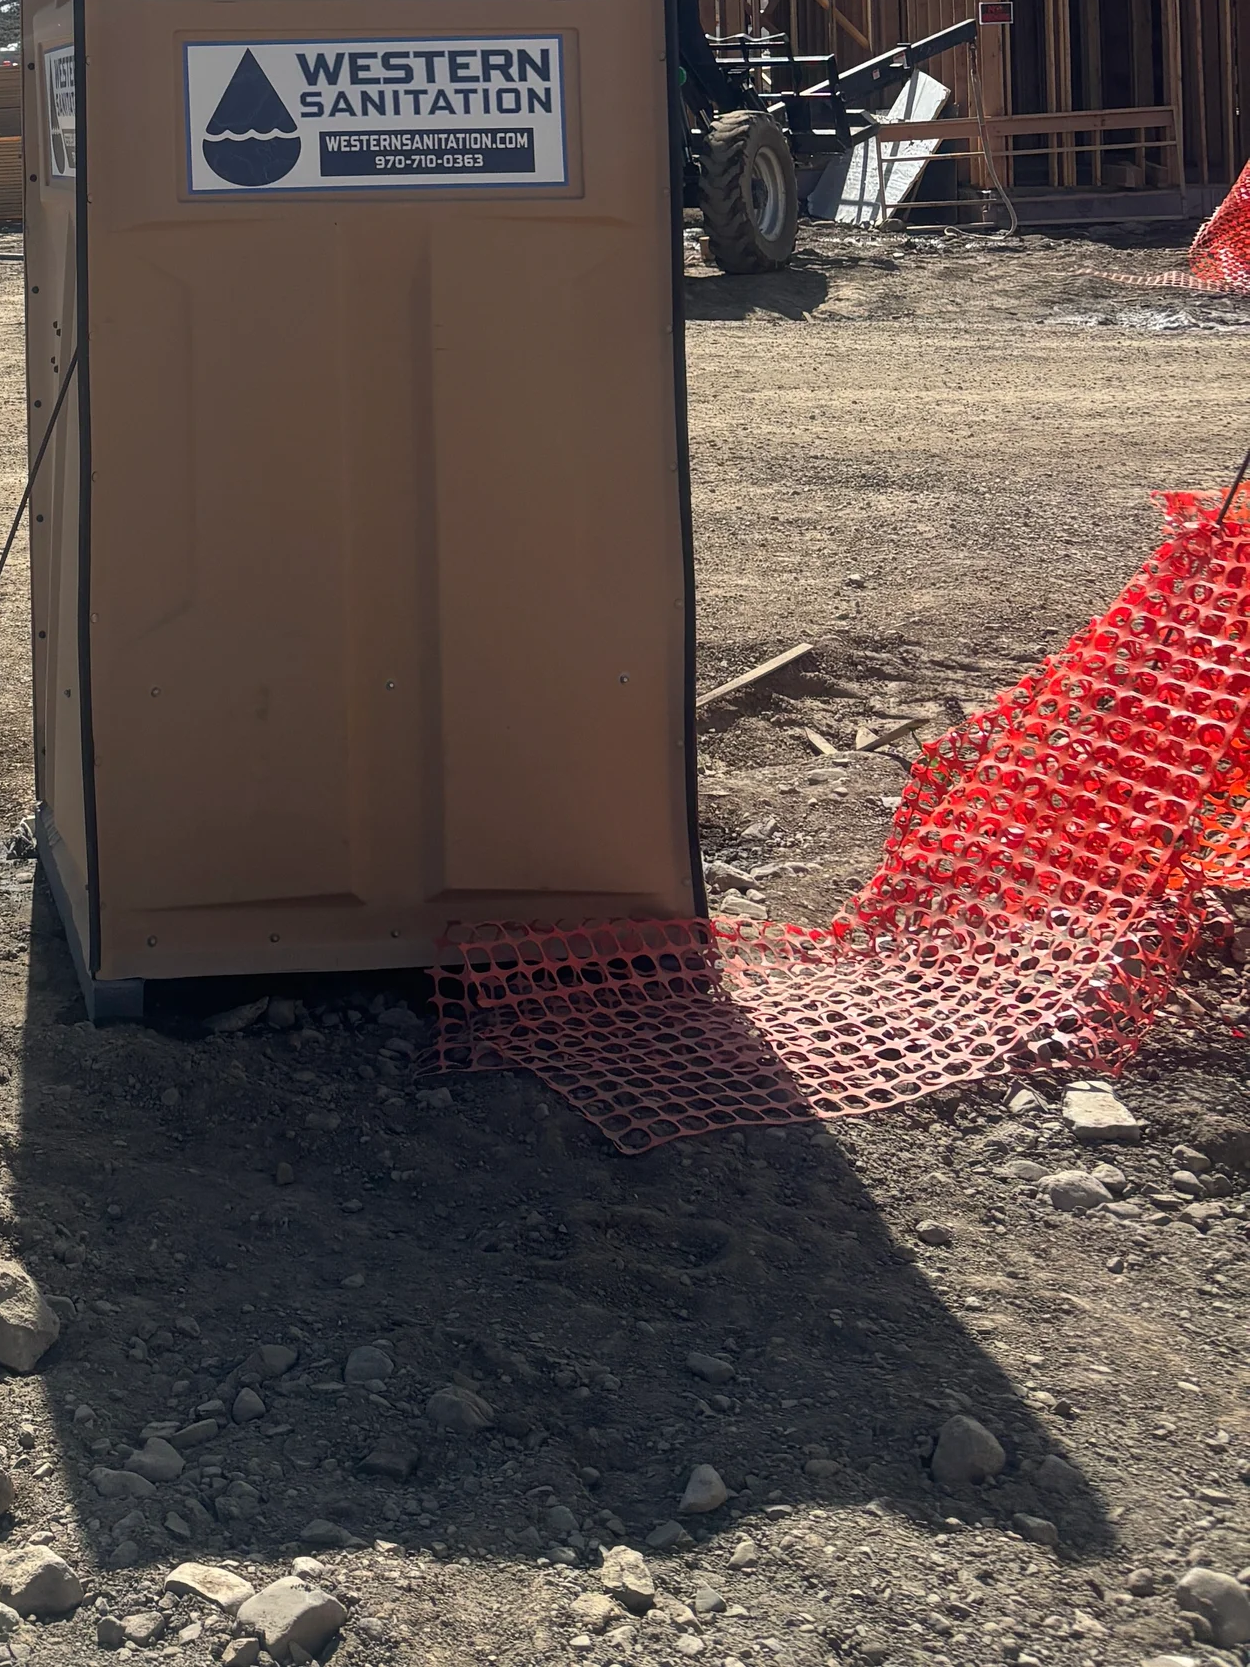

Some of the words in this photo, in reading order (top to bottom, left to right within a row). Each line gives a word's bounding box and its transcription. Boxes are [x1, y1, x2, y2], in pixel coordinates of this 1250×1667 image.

[54, 55, 74, 89] WESTE
[295, 48, 551, 85] WESTERN
[300, 87, 552, 118] SANITATION
[325, 132, 528, 152] WESTERNSANITATION.COM
[375, 154, 484, 170] 970-710-0363
